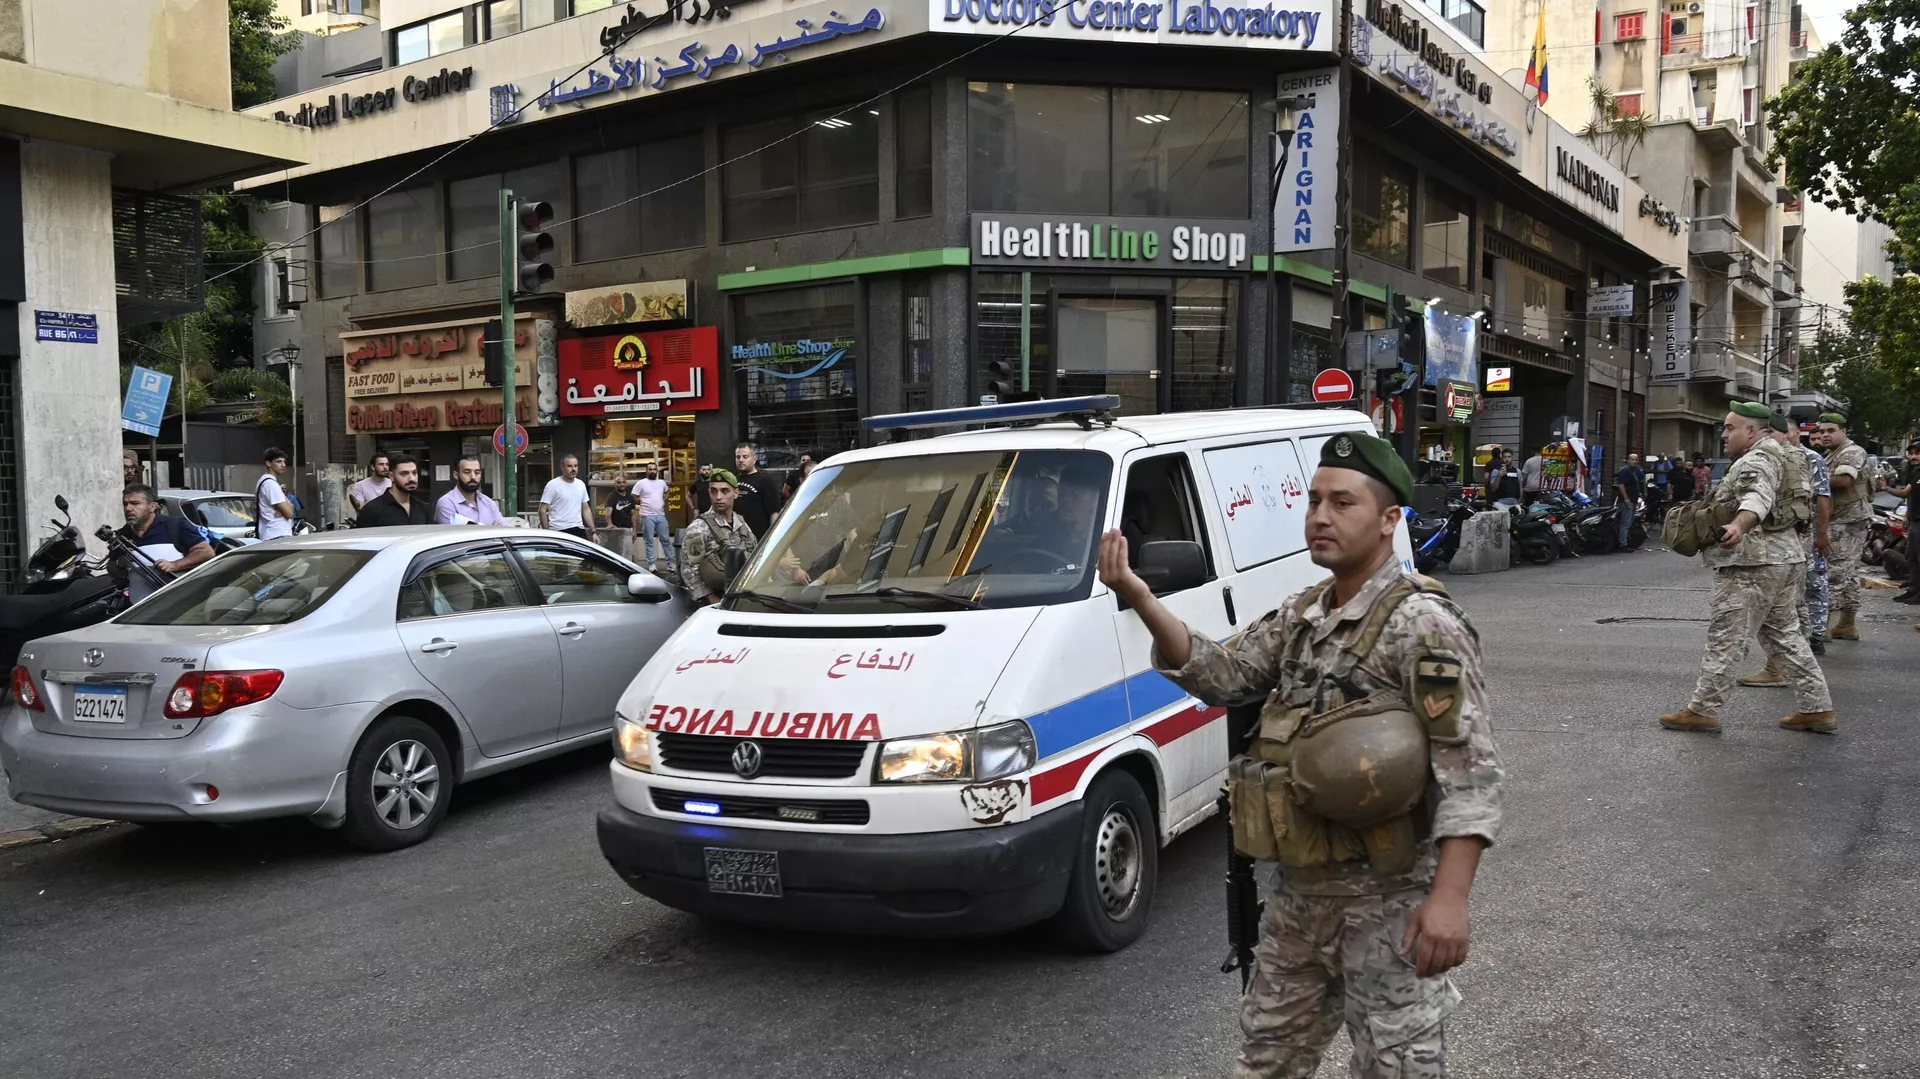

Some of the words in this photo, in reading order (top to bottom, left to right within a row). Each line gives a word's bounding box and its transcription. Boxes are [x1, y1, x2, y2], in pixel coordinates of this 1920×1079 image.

[1066, 0, 1163, 29] Center
[1168, 0, 1321, 47] Laboratory
[747, 8, 887, 68] مختبر
[651, 41, 743, 90] مركز
[341, 87, 396, 119] Laser
[402, 65, 474, 103] Center
[1281, 74, 1332, 91] CENTER
[1556, 146, 1619, 213] MARIGNAN
[980, 220, 1160, 260] HealthLine
[1171, 225, 1247, 268] Shop
[1592, 304, 1630, 312] MARIGNAN
[39, 328, 53, 338] RUE
[55, 330, 67, 339] 86
[348, 374, 370, 388] FAST
[371, 372, 396, 385] FOOD
[354, 388, 366, 396] FREE
[366, 386, 389, 395] DELIVERY
[566, 366, 702, 407] الجامعة
[348, 404, 394, 430] Golden
[394, 402, 439, 429] Sheep
[1491, 403, 1519, 411] CENTER
[675, 647, 751, 675] المدني
[827, 647, 914, 679] الدفاع
[75, 698, 124, 720] G221474
